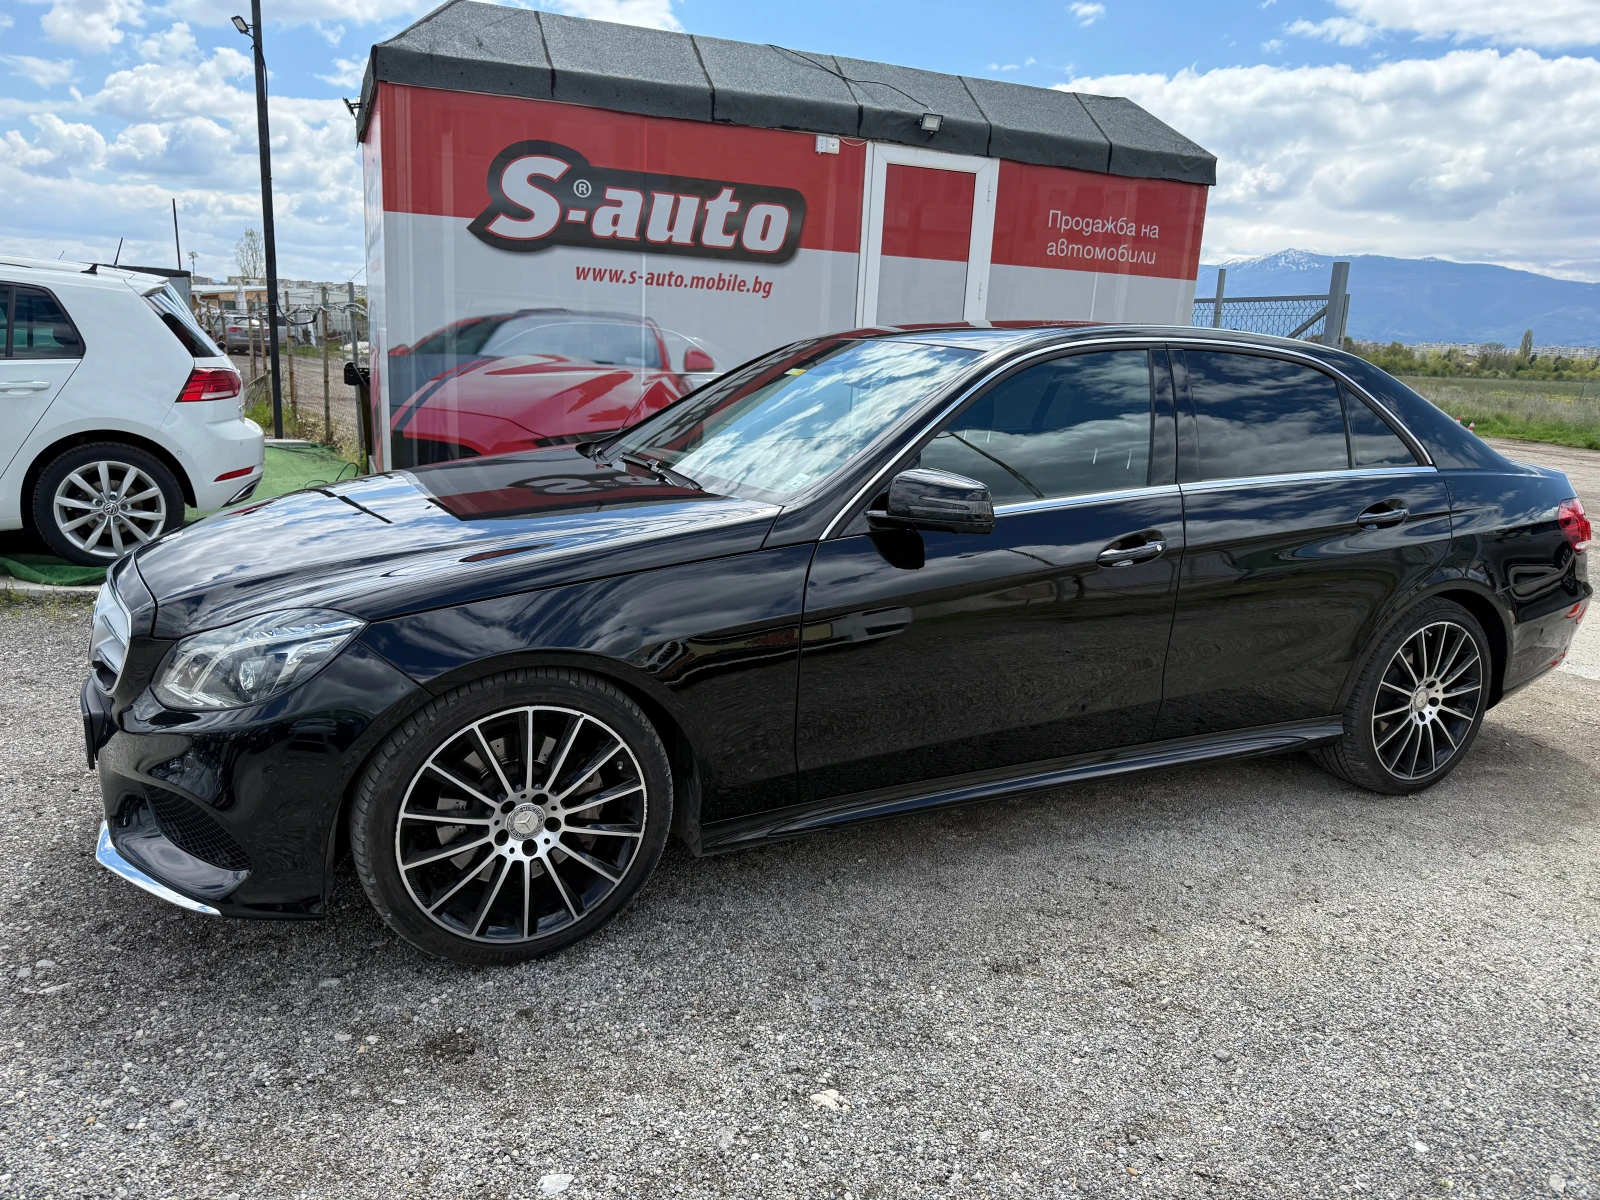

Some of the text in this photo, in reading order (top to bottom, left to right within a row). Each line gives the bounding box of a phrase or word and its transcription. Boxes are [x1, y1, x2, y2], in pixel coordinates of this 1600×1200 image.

[486, 154, 790, 253] S-auto
[1048, 209, 1159, 239] Продажба на
[1046, 238, 1157, 265] автомобили
[575, 265, 773, 299] www.s-auto.mobile.bg
